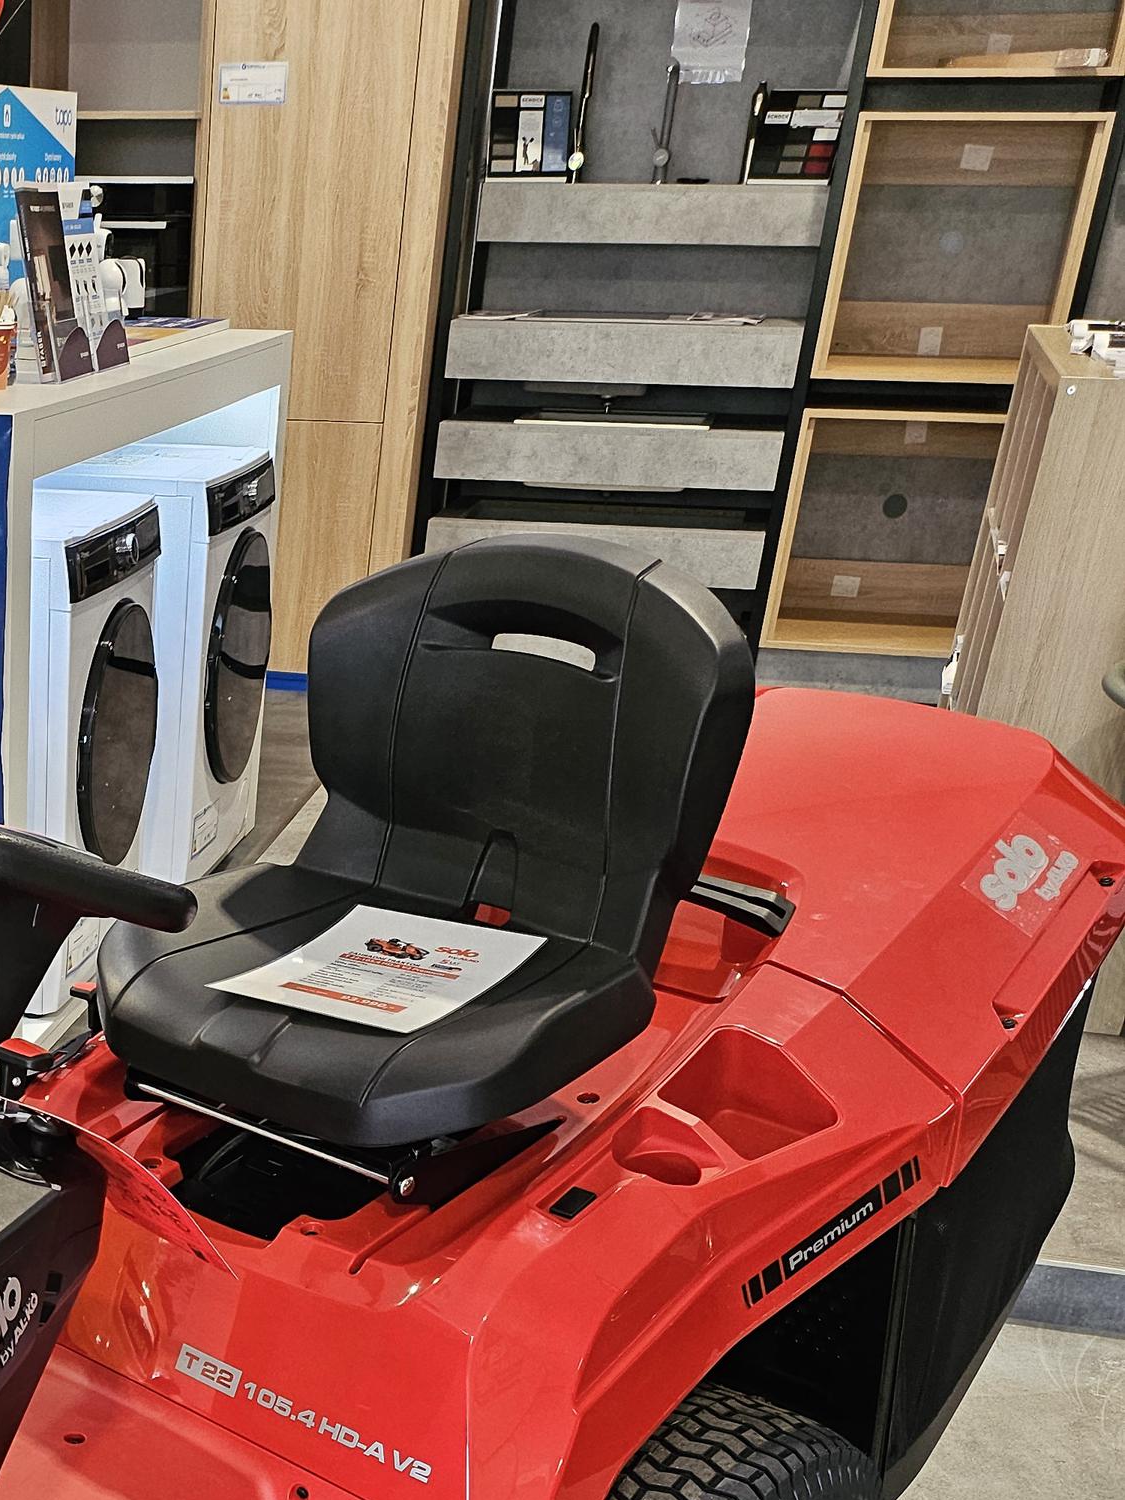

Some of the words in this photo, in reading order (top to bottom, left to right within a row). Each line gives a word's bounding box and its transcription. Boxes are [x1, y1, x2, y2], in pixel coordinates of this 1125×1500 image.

[788, 1201, 874, 1271] Premium
[0, 1340, 14, 1366] by
[184, 1352, 200, 1370] T
[200, 1361, 235, 1389] 22
[244, 1381, 316, 1429] 105.4
[318, 1416, 385, 1463] HD-A
[392, 1449, 433, 1484] V2
